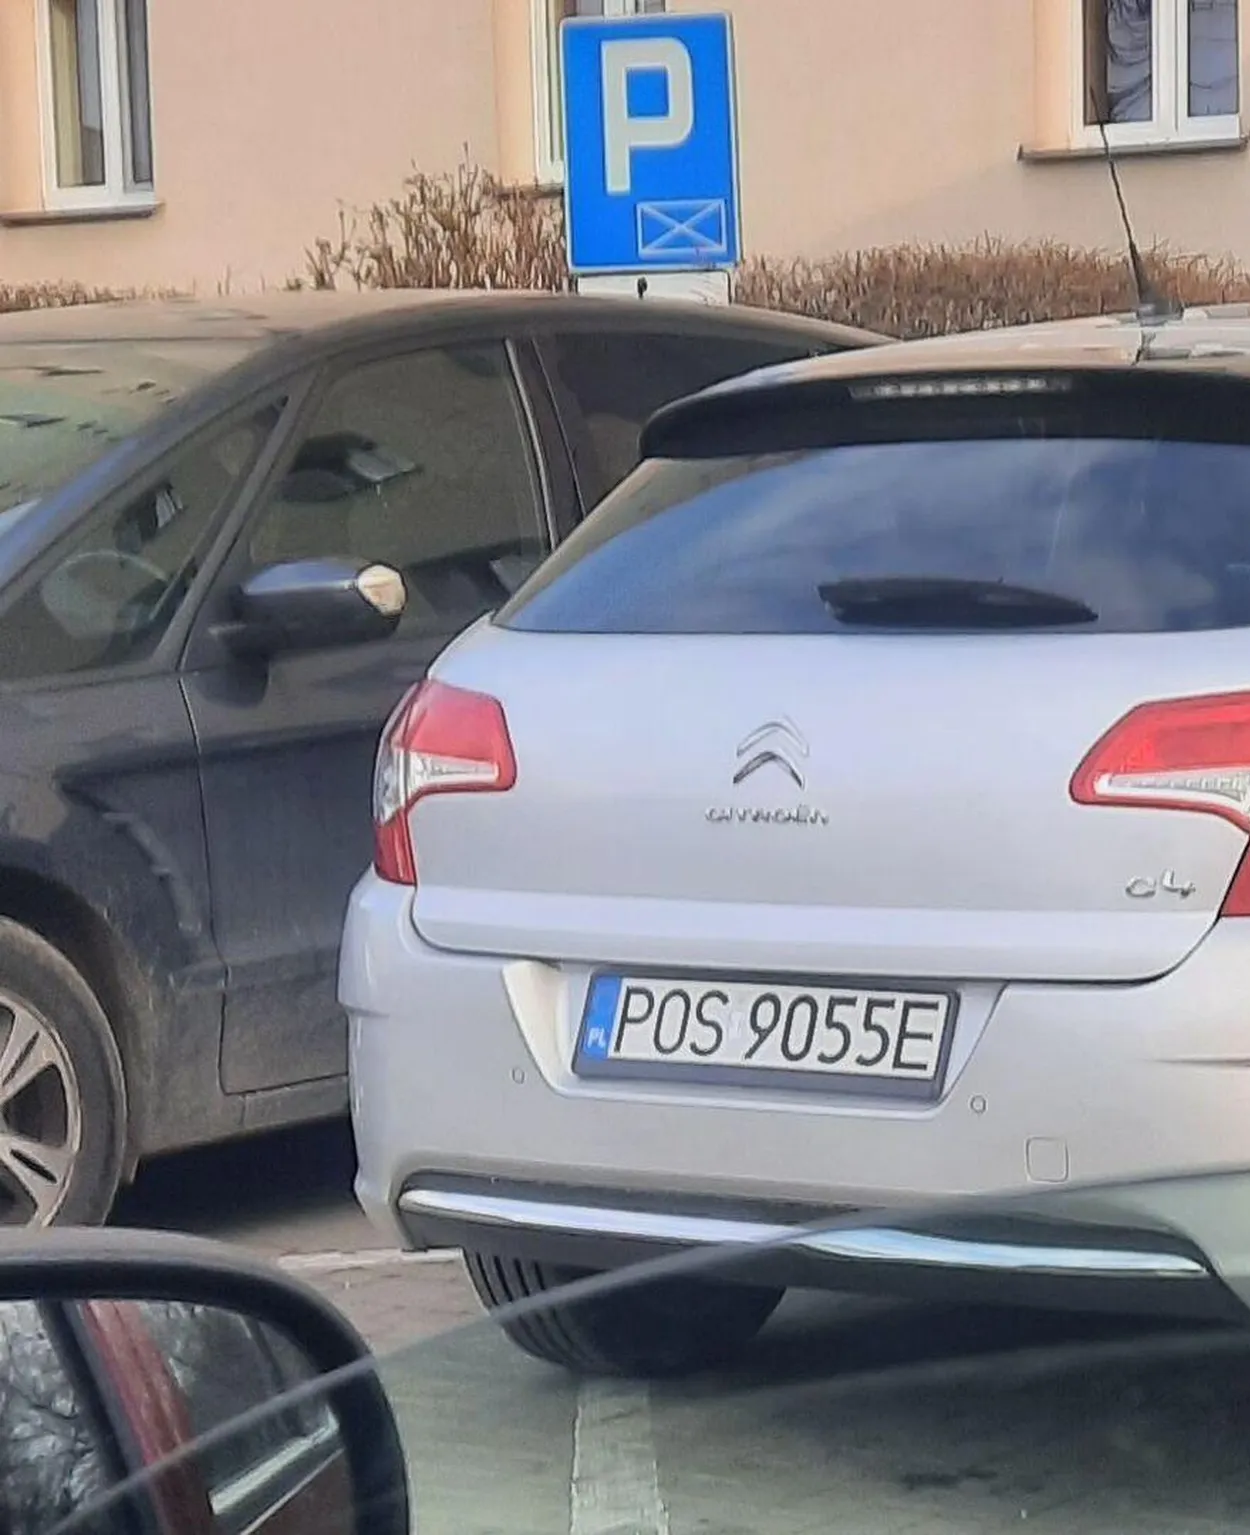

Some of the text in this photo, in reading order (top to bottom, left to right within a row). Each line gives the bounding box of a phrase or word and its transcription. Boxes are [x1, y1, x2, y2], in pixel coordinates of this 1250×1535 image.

[601, 37, 694, 195] P
[1125, 867, 1196, 899] C4
[587, 1027, 606, 1049] PL
[613, 986, 940, 1072] POS 9055E
